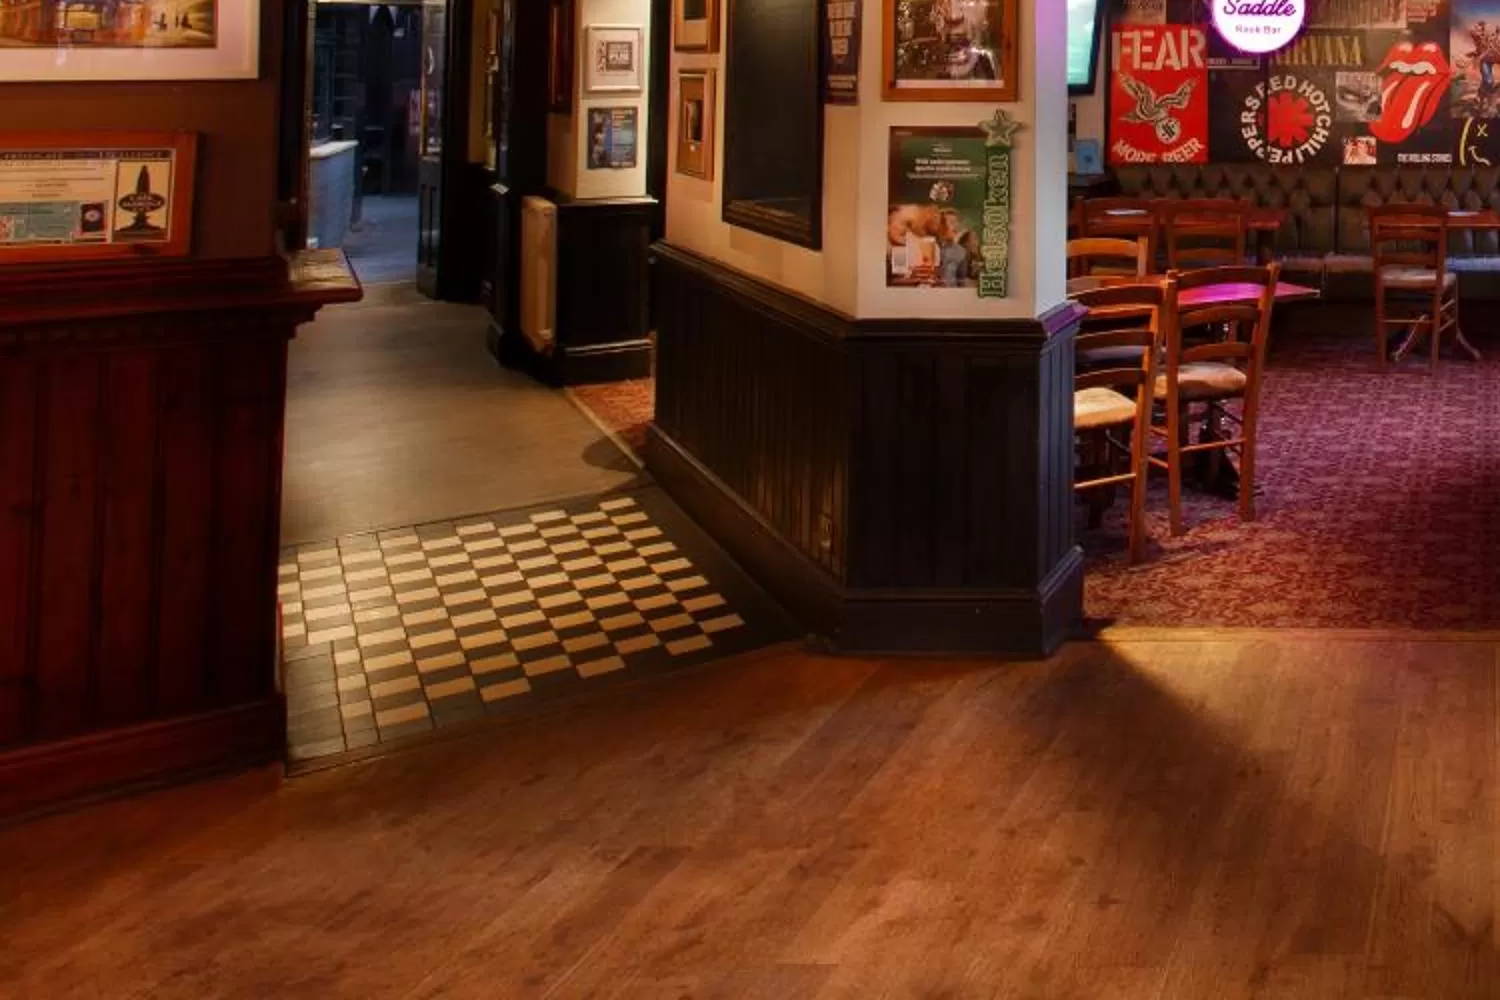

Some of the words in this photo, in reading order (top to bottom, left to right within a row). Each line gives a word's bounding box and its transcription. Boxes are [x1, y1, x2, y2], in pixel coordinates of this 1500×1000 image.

[1111, 28, 1207, 72] FEAR
[1297, 80, 1331, 113] HOT
[1295, 114, 1331, 164] CHILI
